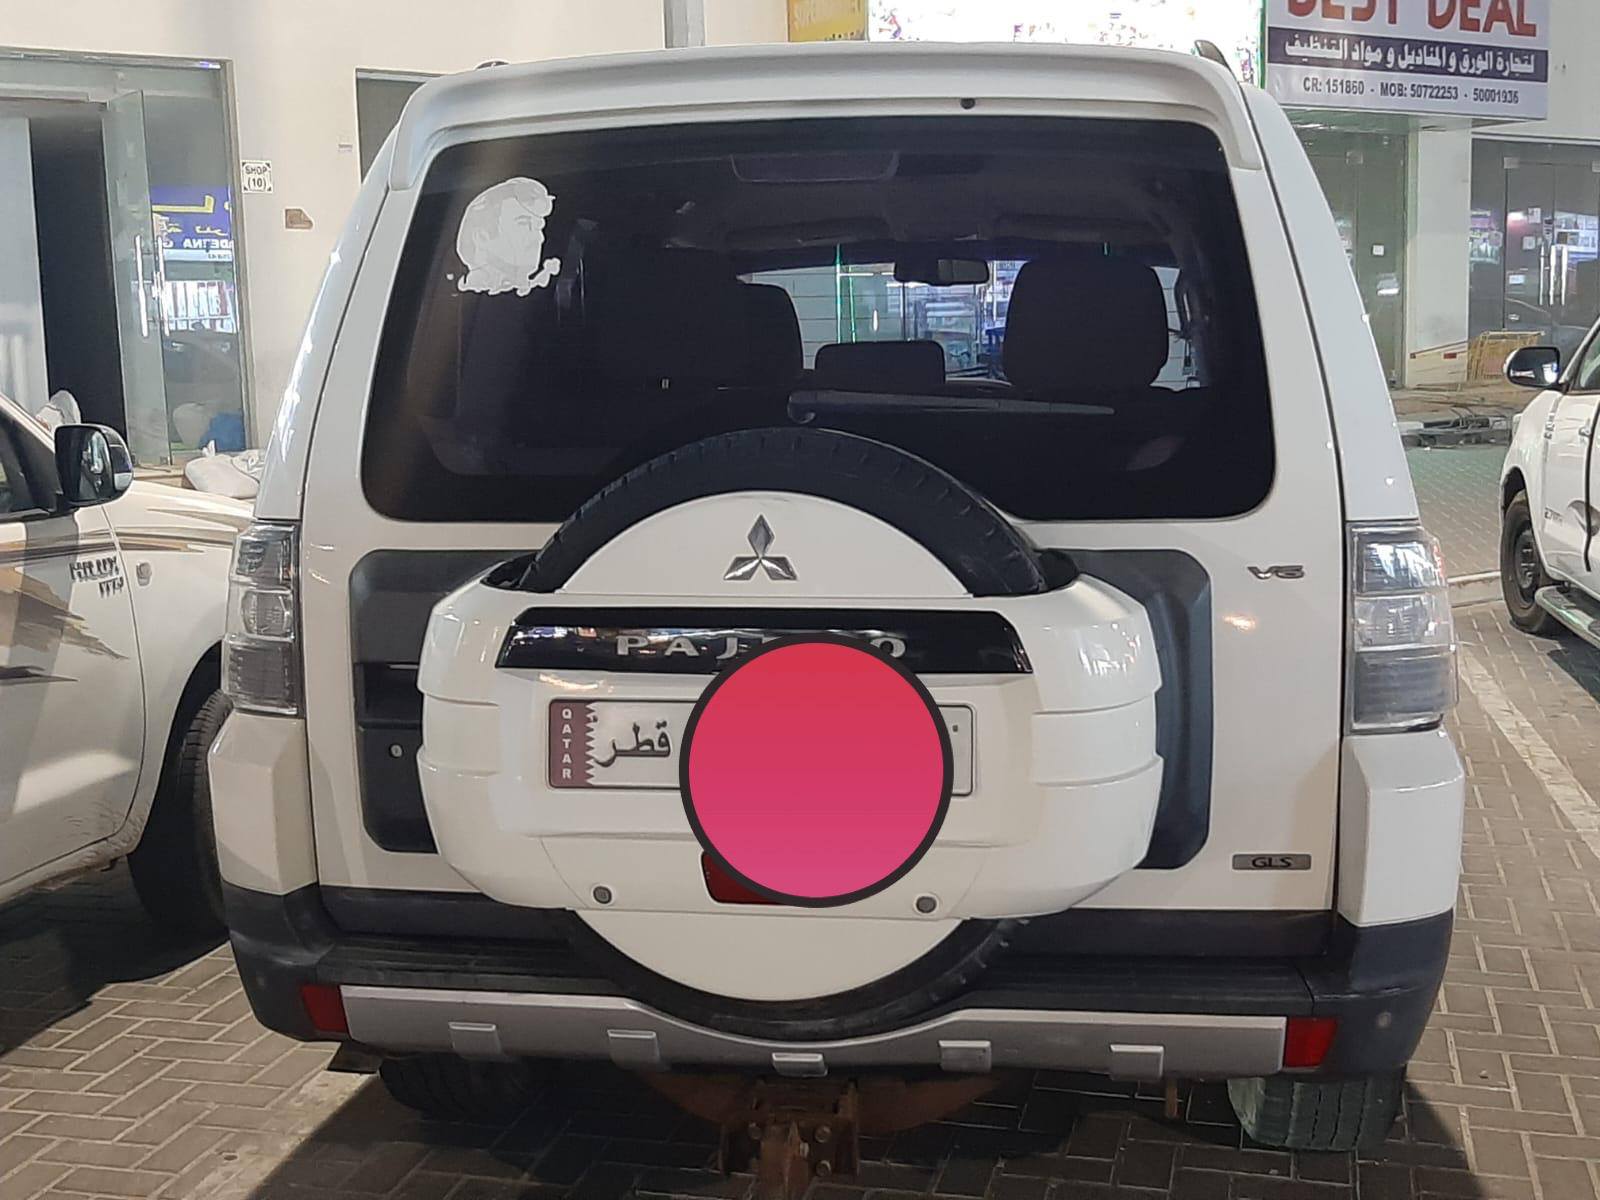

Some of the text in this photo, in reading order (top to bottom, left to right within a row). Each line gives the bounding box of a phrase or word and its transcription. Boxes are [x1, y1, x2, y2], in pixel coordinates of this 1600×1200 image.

[1427, 0, 1537, 37] DEAL
[1285, 33, 1535, 77] لتجارة الورق و المناديل و مواد التنظيف
[1303, 76, 1322, 93] CR:
[1325, 78, 1365, 96] 151860
[1379, 81, 1408, 98] MOB:
[1410, 82, 1459, 100] 50722253
[247, 177, 267, 190] (10)
[1246, 564, 1305, 580] V6
[615, 634, 906, 660] PAJO
[561, 708, 572, 779] QATAR
[593, 720, 671, 768] قطر
[1251, 856, 1294, 869] GLS
